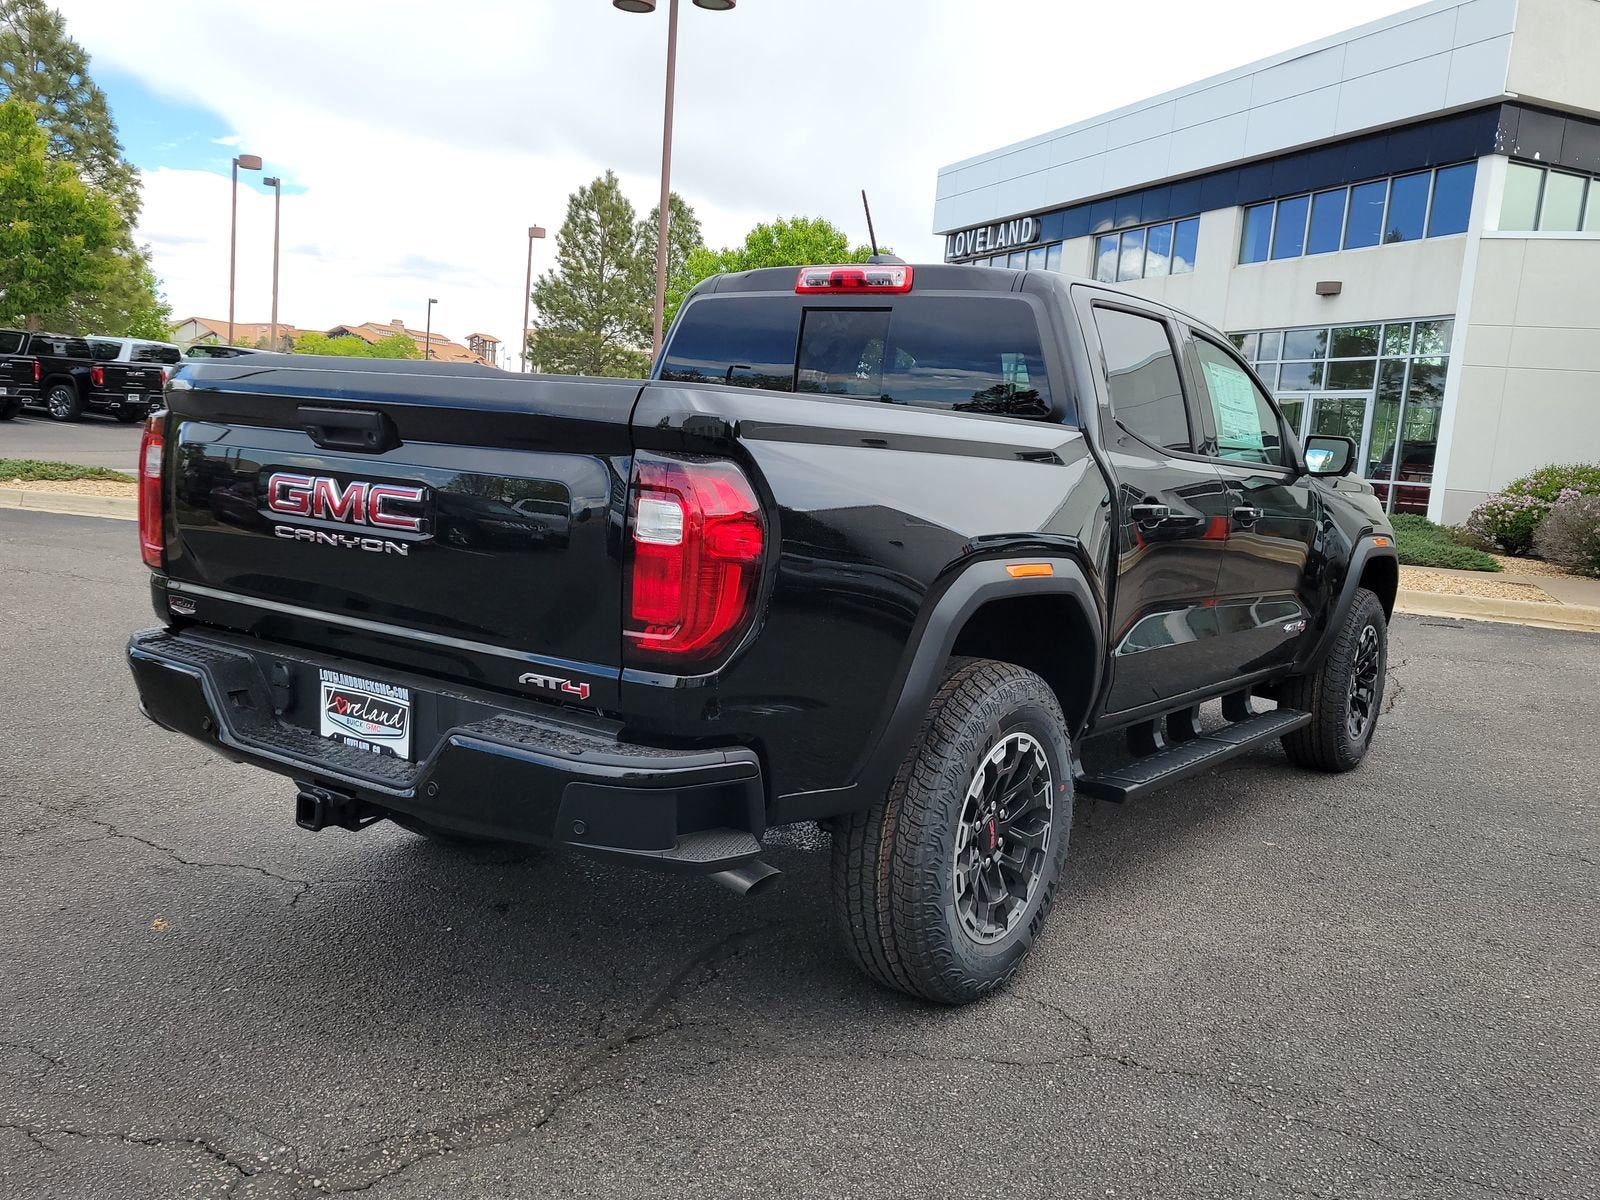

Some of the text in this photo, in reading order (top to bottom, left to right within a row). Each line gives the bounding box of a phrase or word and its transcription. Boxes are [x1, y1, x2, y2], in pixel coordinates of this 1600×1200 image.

[946, 217, 1035, 257] LOVELAND
[268, 472, 425, 531] GMC
[274, 525, 409, 556] CANYON
[518, 672, 590, 700] AT4
[346, 718, 381, 732] BUICK GMC
